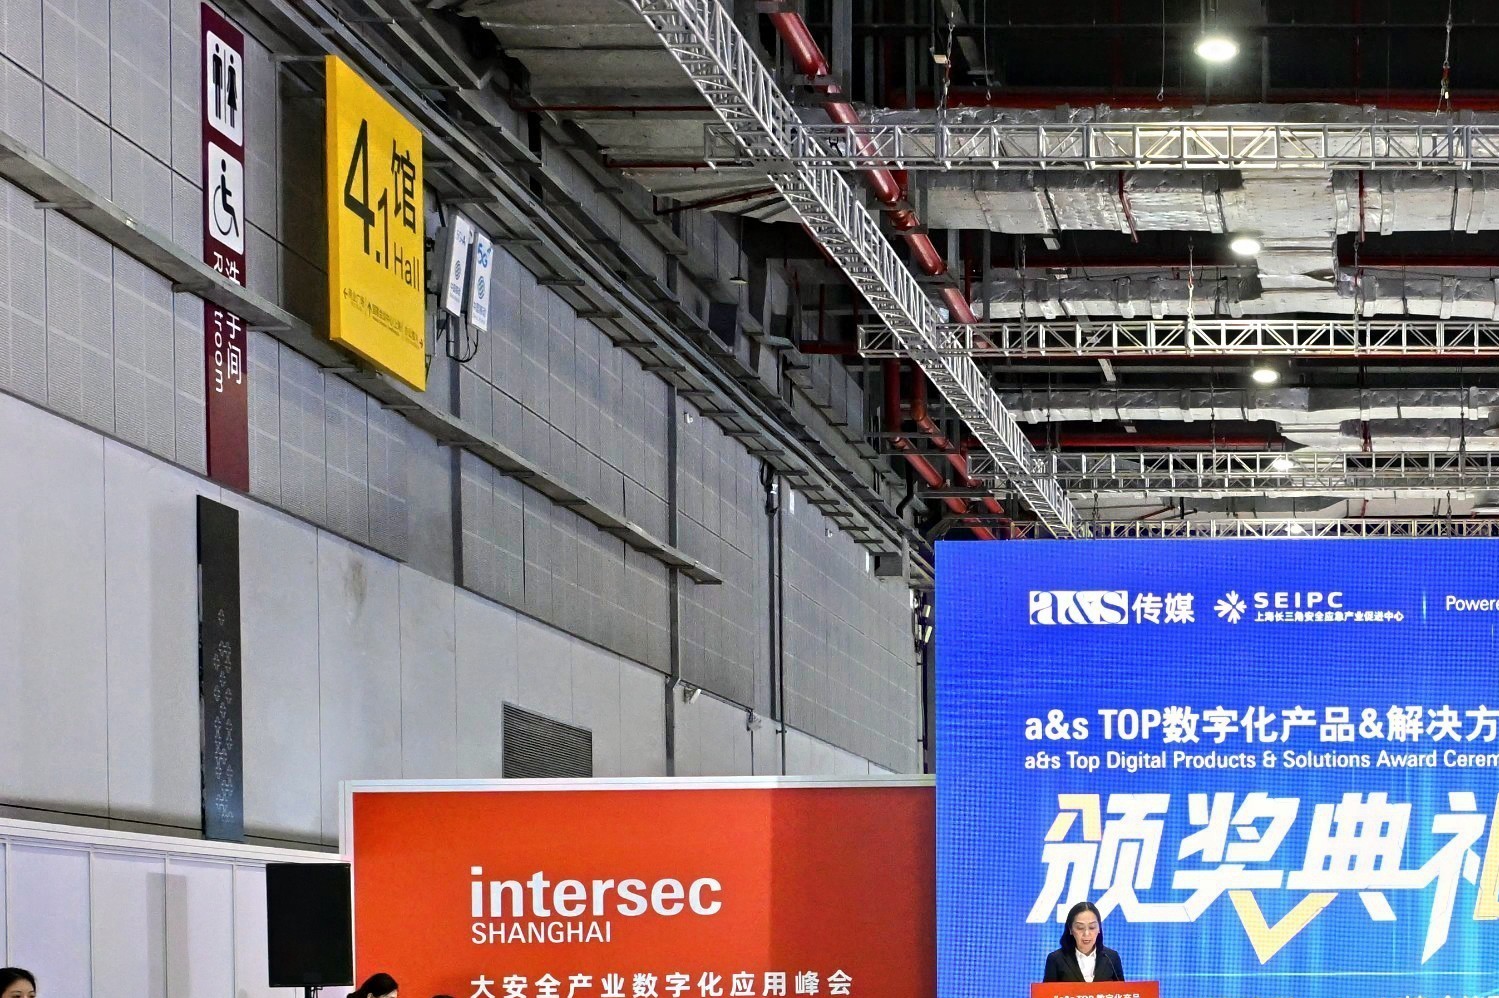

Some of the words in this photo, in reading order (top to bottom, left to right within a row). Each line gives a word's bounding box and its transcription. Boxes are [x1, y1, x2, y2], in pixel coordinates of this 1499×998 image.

[344, 118, 389, 270] 4.1
[391, 138, 417, 234] 馆
[394, 242, 420, 293] Hall
[1030, 590, 1129, 625] a&s
[1131, 592, 1195, 625] 传媒
[1253, 591, 1343, 609] SEIPC
[1024, 708, 1089, 741] a&s
[1024, 751, 1061, 770] a&s
[1066, 751, 1100, 773] Top
[1106, 750, 1167, 773] Digital
[1173, 751, 1257, 769] Products
[1262, 751, 1278, 768] &
[1283, 750, 1371, 769] Solutions
[1376, 750, 1437, 768] Award
[471, 866, 722, 917] intersec
[471, 921, 611, 944] SHANGHAI
